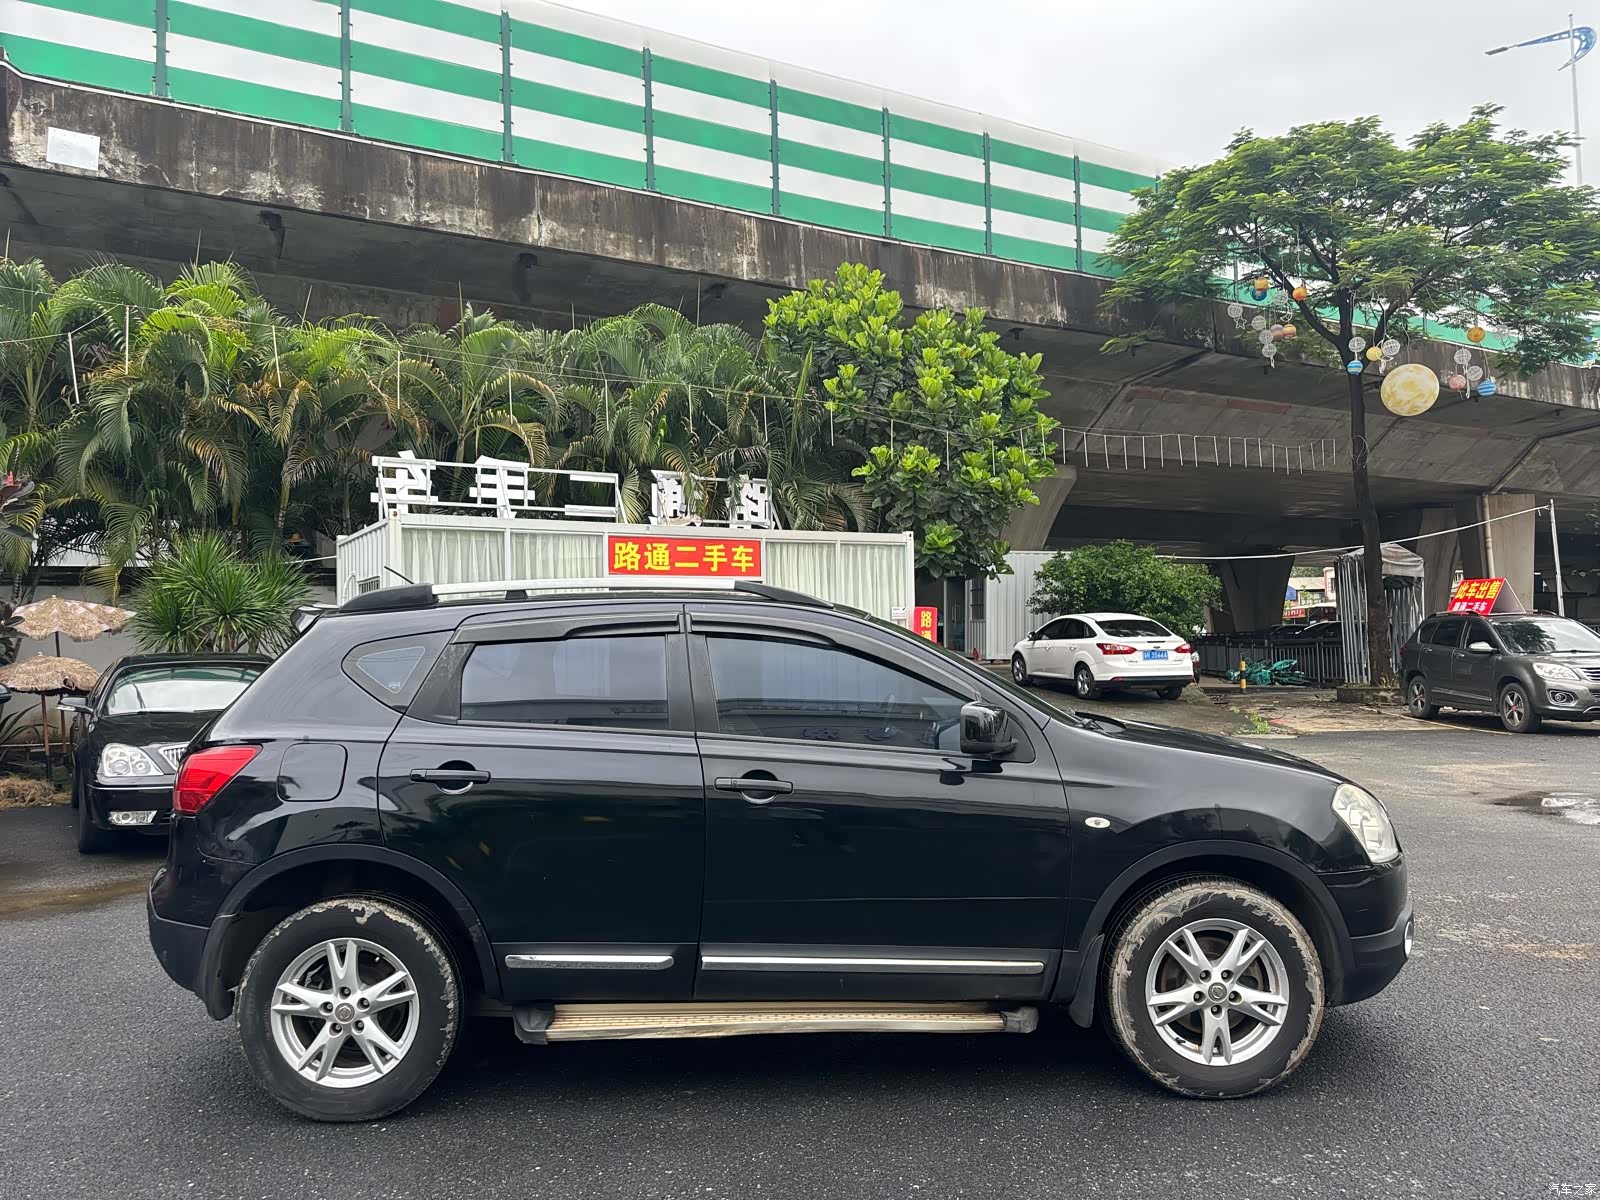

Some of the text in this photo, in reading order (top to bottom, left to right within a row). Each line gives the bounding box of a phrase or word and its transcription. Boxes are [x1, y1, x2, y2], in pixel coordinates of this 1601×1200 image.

[613, 541, 755, 573] 路通二手车
[1454, 580, 1502, 599] 此车出售
